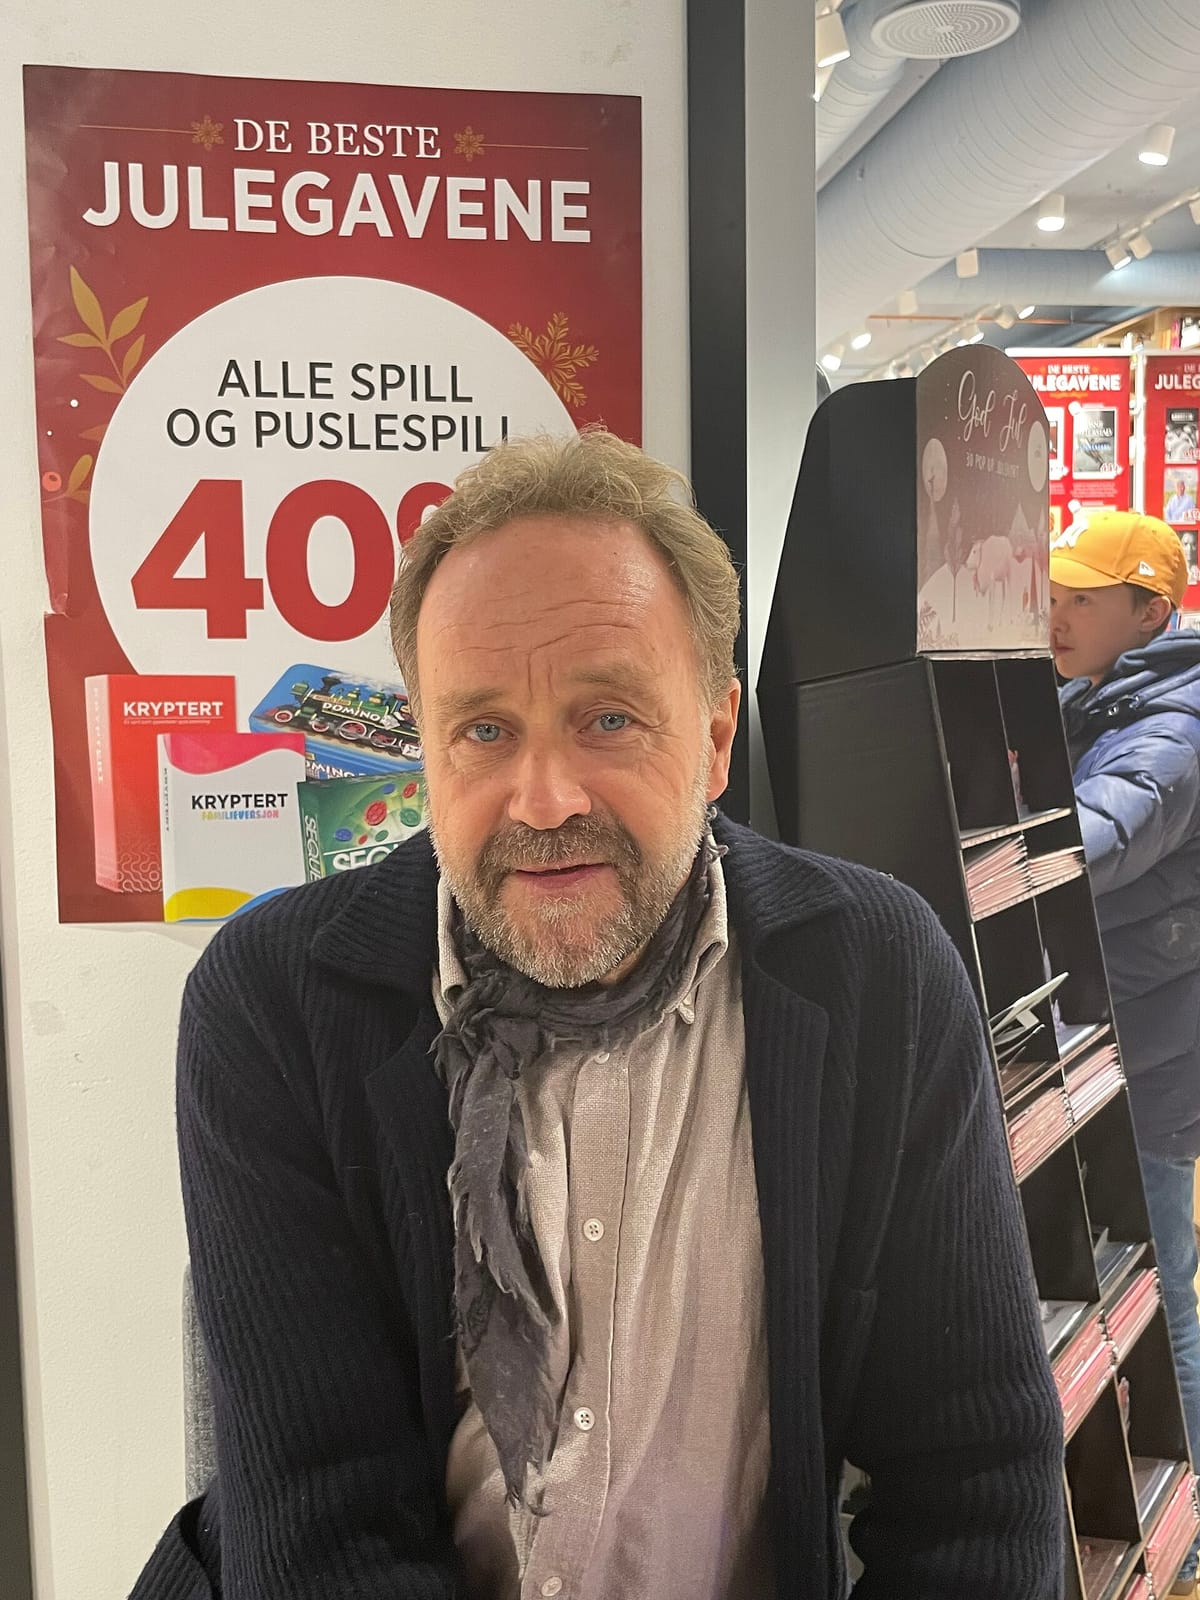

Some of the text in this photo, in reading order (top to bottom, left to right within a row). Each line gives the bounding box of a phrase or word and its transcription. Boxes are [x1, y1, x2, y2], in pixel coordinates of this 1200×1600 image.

[234, 119, 441, 159] DE BESTE
[83, 161, 592, 243] JULEGAVENE
[217, 359, 473, 404] ALLE SPILL
[166, 408, 236, 448] OG
[130, 479, 455, 642] 40
[123, 701, 224, 717] KRYPTERT
[322, 702, 381, 722] DOMINO
[191, 793, 289, 810] KRYPTERT
